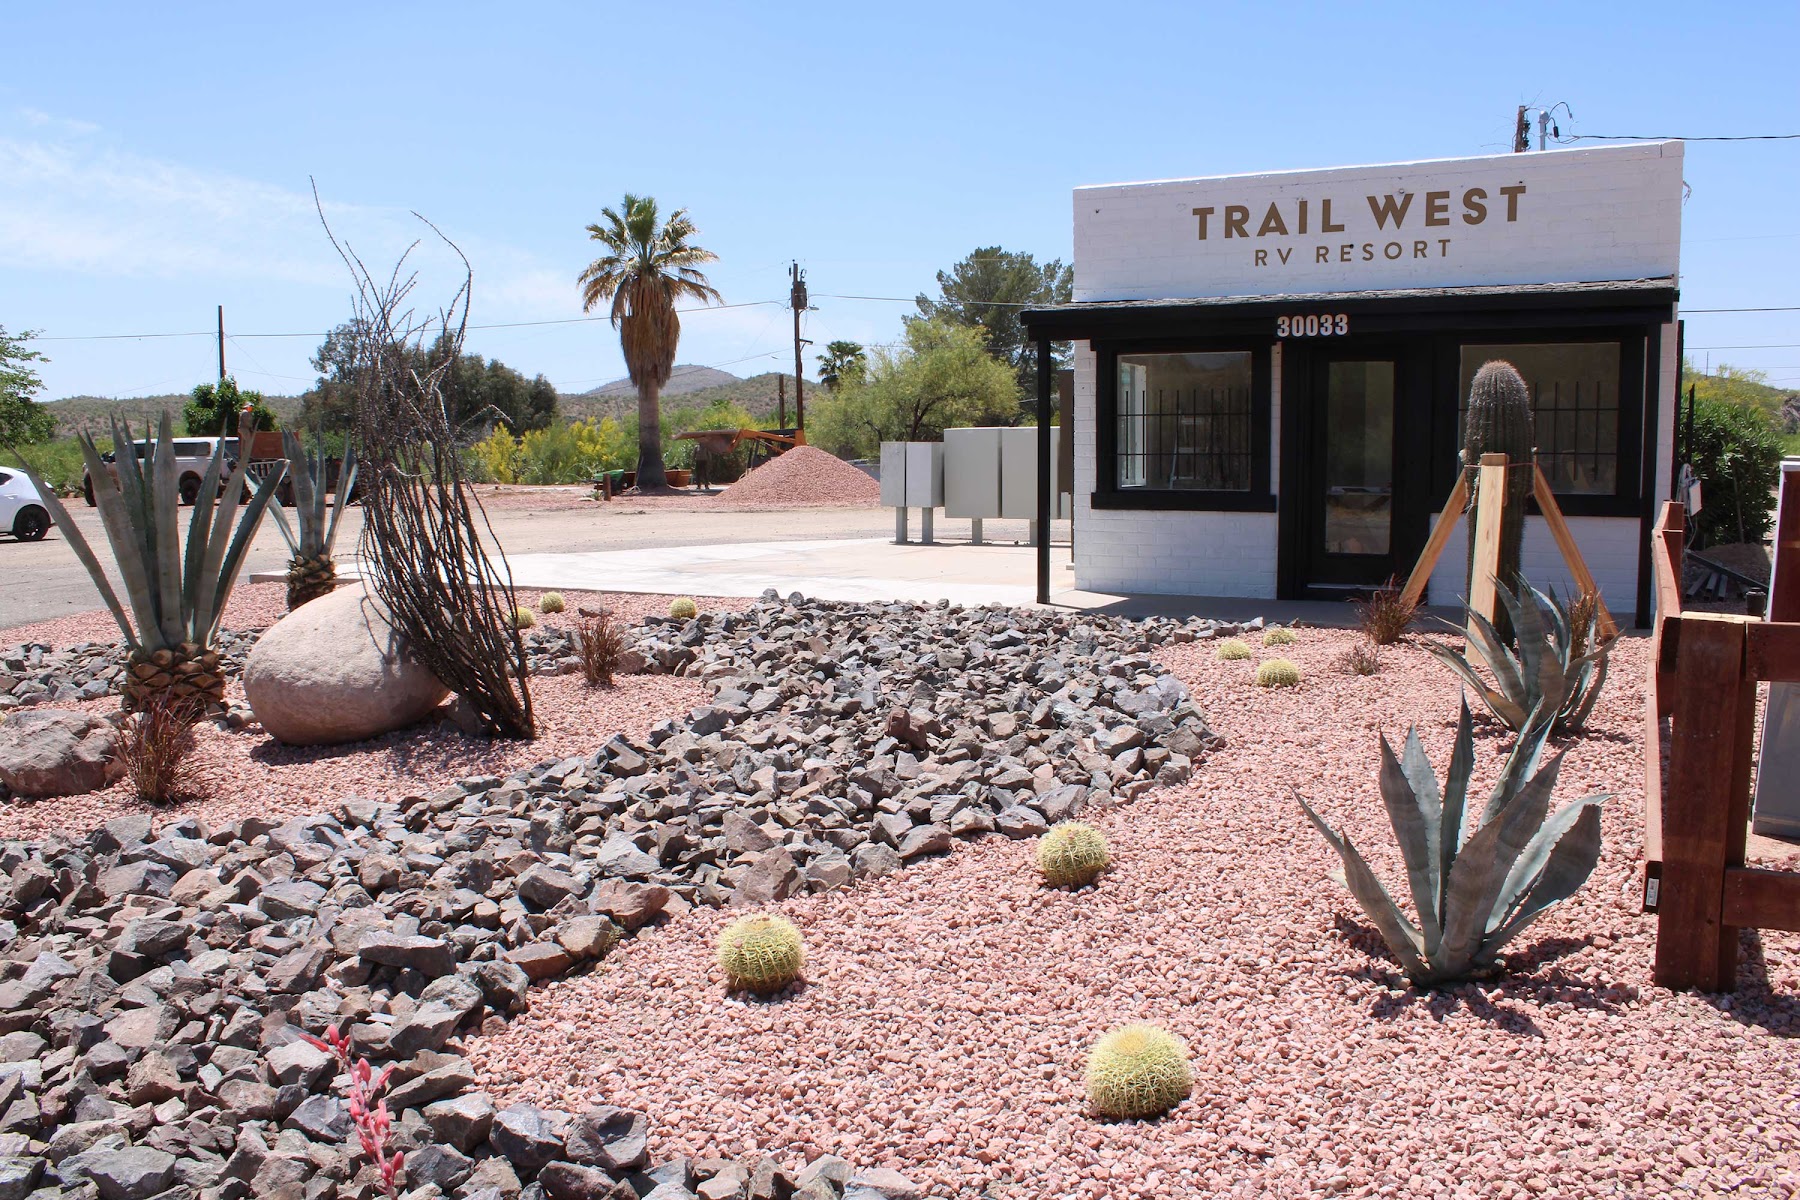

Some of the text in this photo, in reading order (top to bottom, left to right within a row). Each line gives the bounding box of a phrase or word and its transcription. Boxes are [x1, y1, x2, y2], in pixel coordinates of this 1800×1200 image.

[1192, 185, 1526, 240] TRAIL WEST
[1254, 239, 1451, 267] RV RESORT
[1277, 313, 1348, 337] 30033
